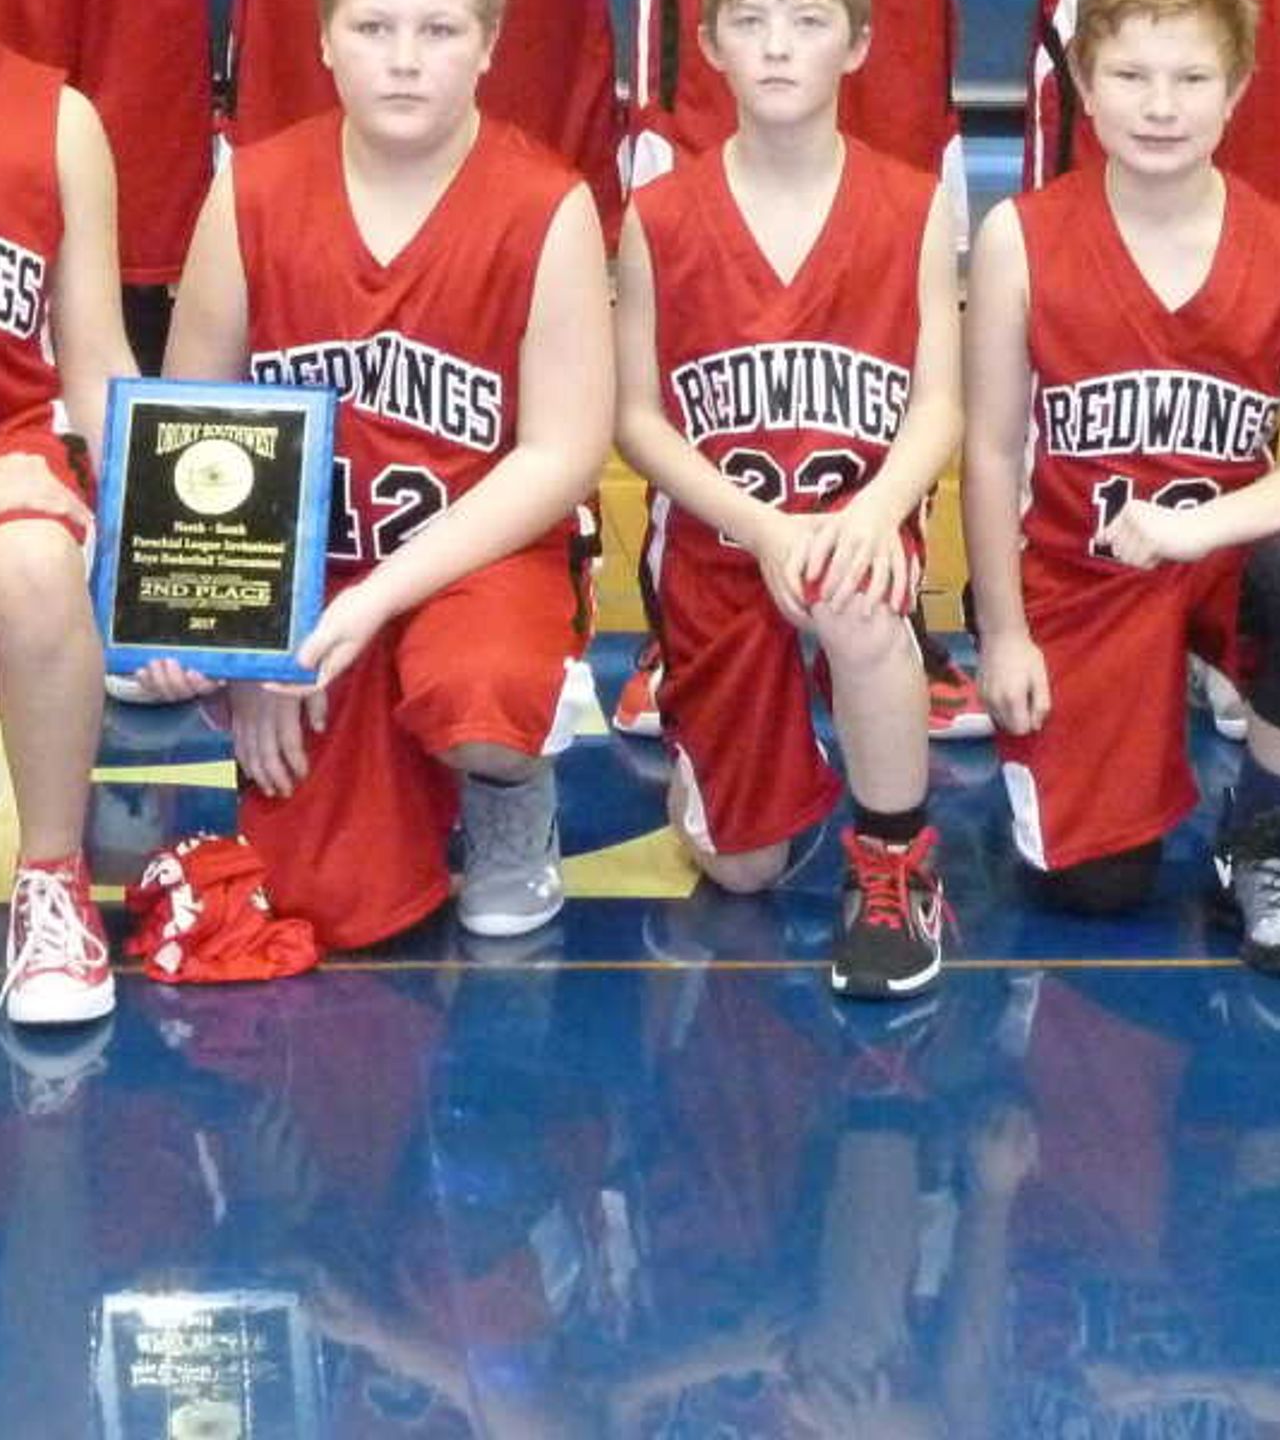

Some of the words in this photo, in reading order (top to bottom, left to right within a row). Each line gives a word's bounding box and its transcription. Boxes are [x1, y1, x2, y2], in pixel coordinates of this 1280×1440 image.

[671, 340, 910, 448] REDWINGS
[1088, 475, 1220, 558] 1
[141, 582, 189, 597] 2ND
[195, 584, 272, 601] PLACE
